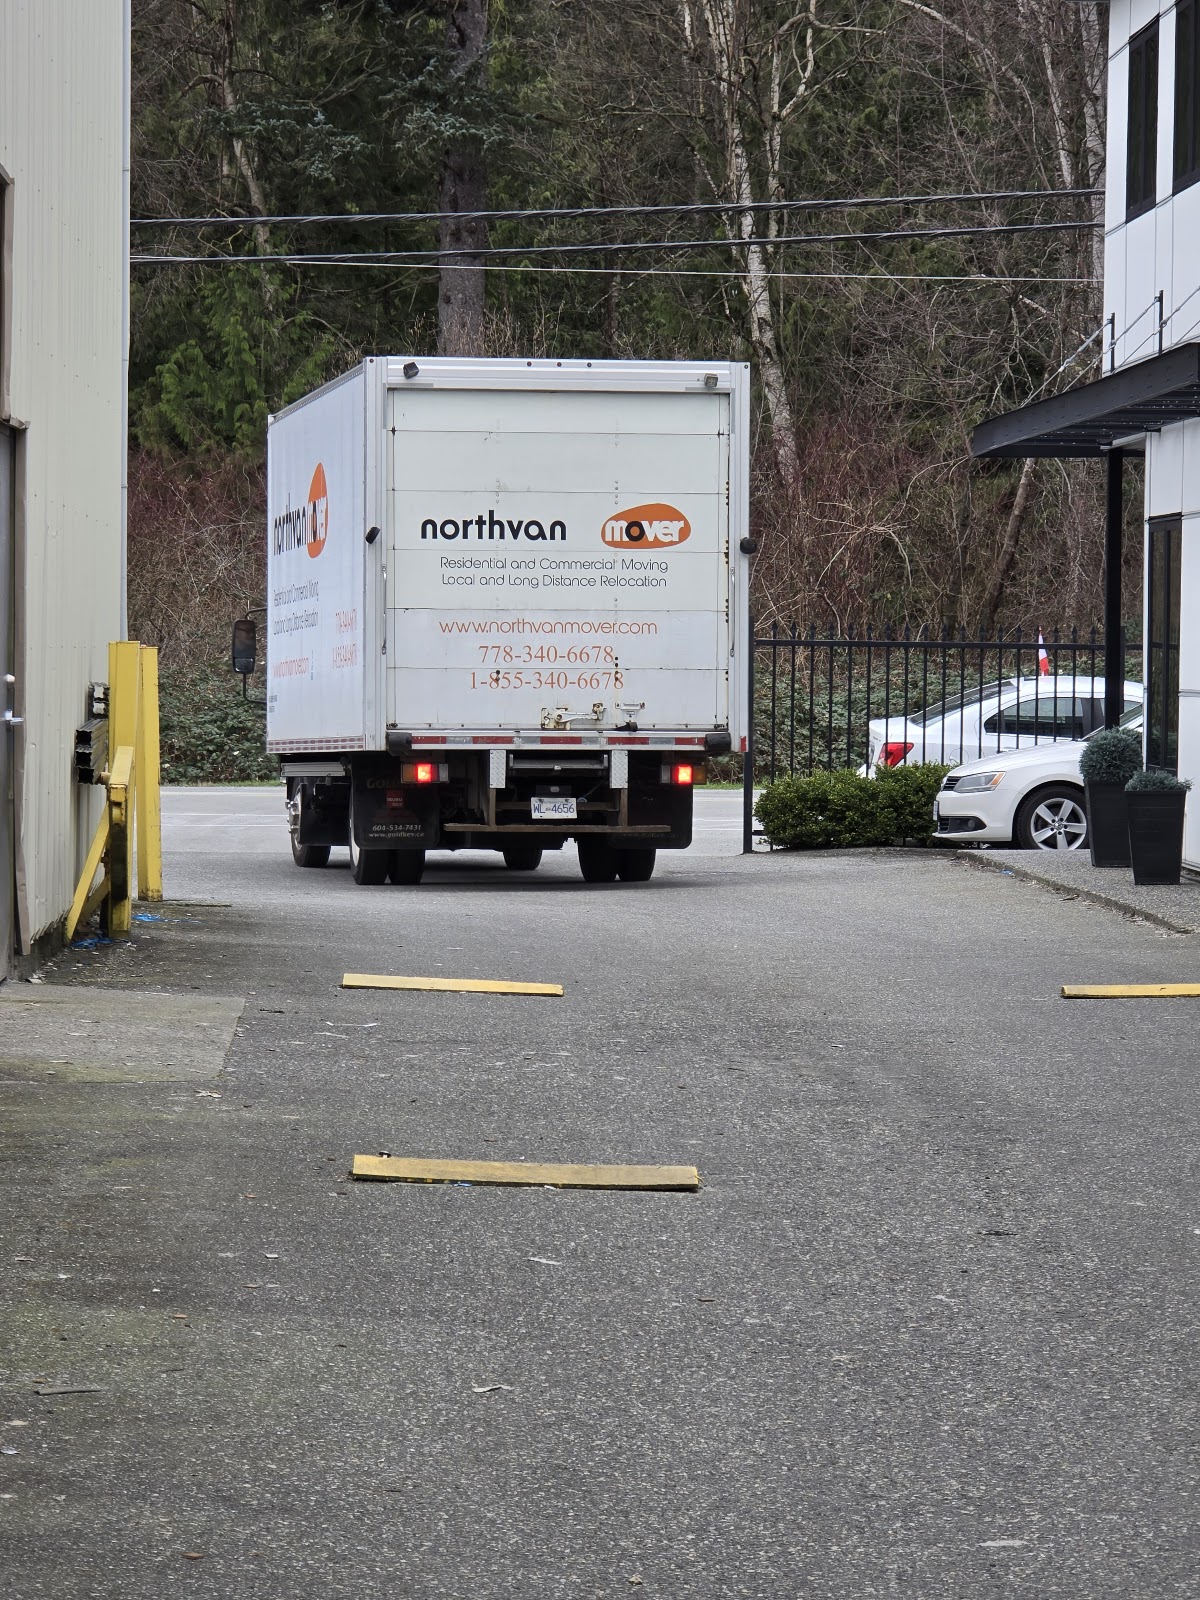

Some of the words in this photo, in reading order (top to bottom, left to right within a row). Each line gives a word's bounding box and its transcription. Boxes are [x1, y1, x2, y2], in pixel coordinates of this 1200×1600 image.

[420, 509, 567, 541] northvan
[604, 519, 685, 542] mover
[440, 556, 507, 570] Residential
[510, 557, 536, 570] and
[539, 557, 616, 571] Commercial
[621, 558, 669, 574] Moving
[441, 573, 476, 586] Local
[479, 574, 505, 586] and
[507, 574, 540, 589] Long
[542, 574, 597, 587] Distance
[600, 575, 668, 588] Relocation
[439, 618, 658, 635] www.northvanmover.com
[478, 645, 614, 664] 778-340-6678
[470, 671, 624, 690] 1-855-340-6678
